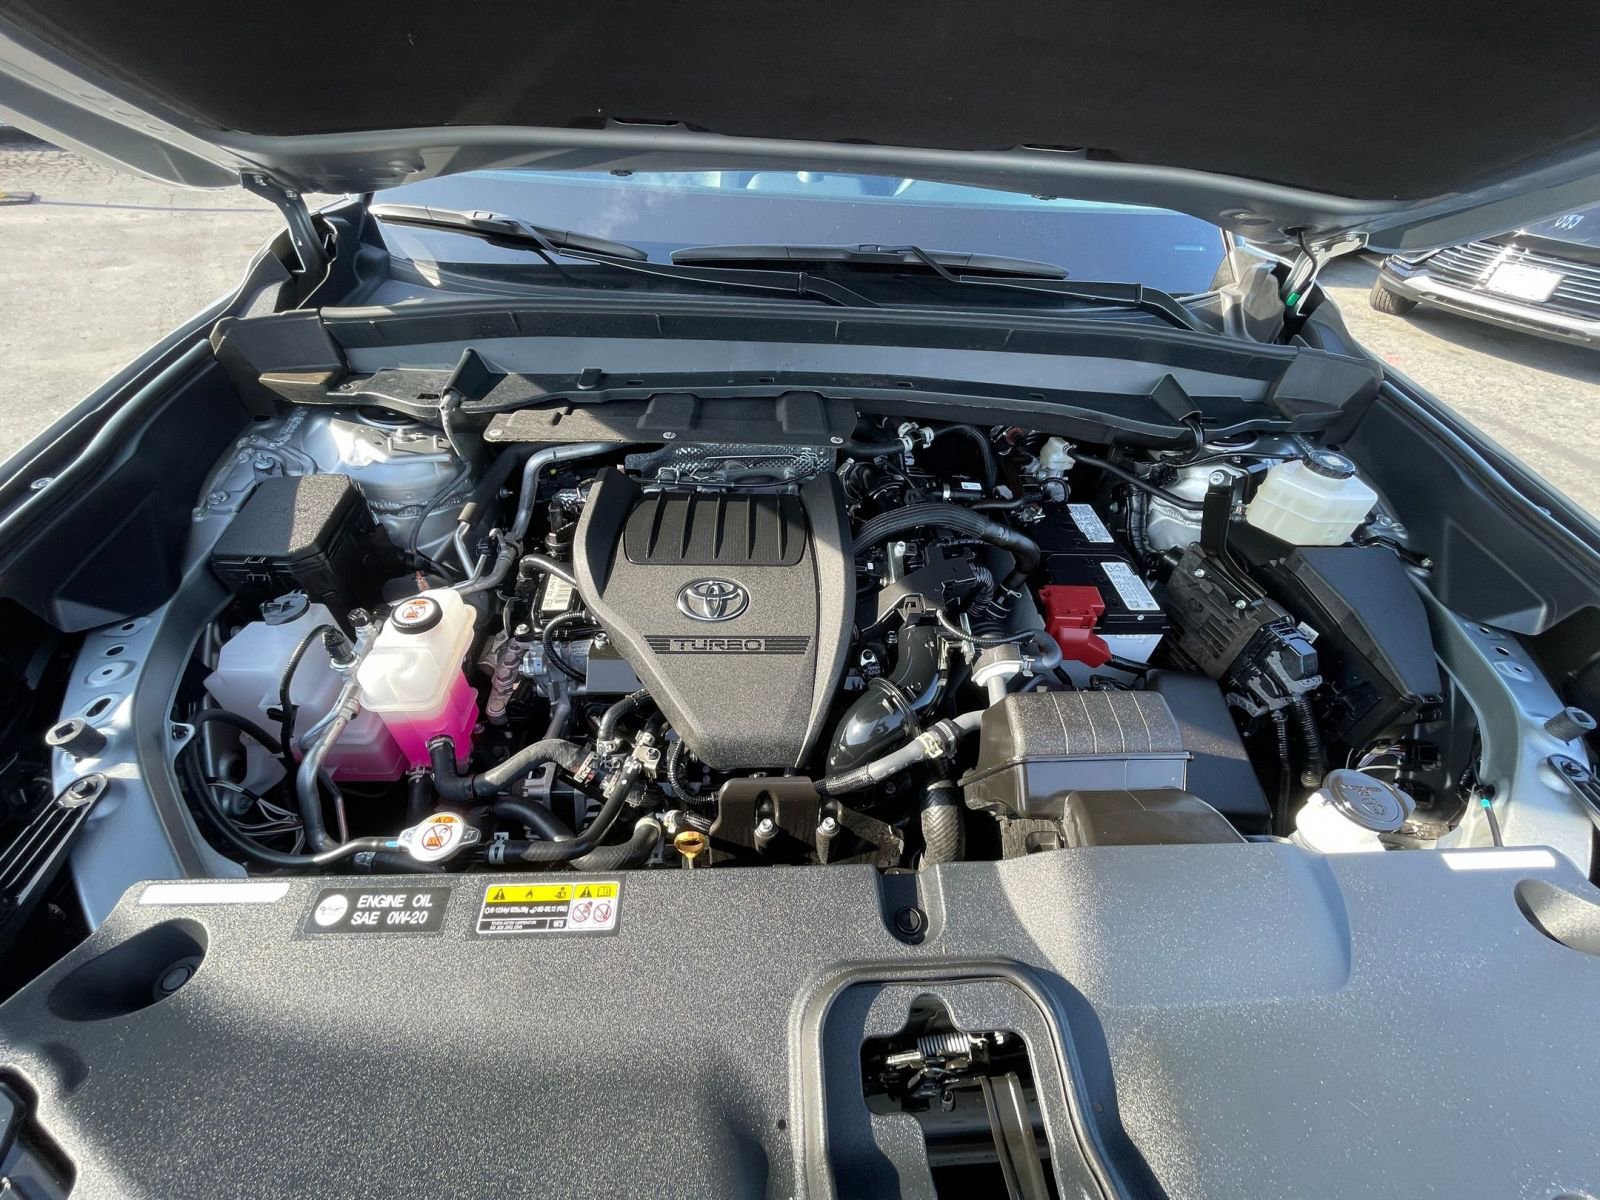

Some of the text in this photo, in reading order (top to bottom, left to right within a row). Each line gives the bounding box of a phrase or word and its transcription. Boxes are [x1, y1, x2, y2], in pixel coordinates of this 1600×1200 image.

[673, 639, 763, 651] TURBO
[356, 894, 433, 908] ENGINE OIL
[350, 910, 429, 925] SAE 0W-20
